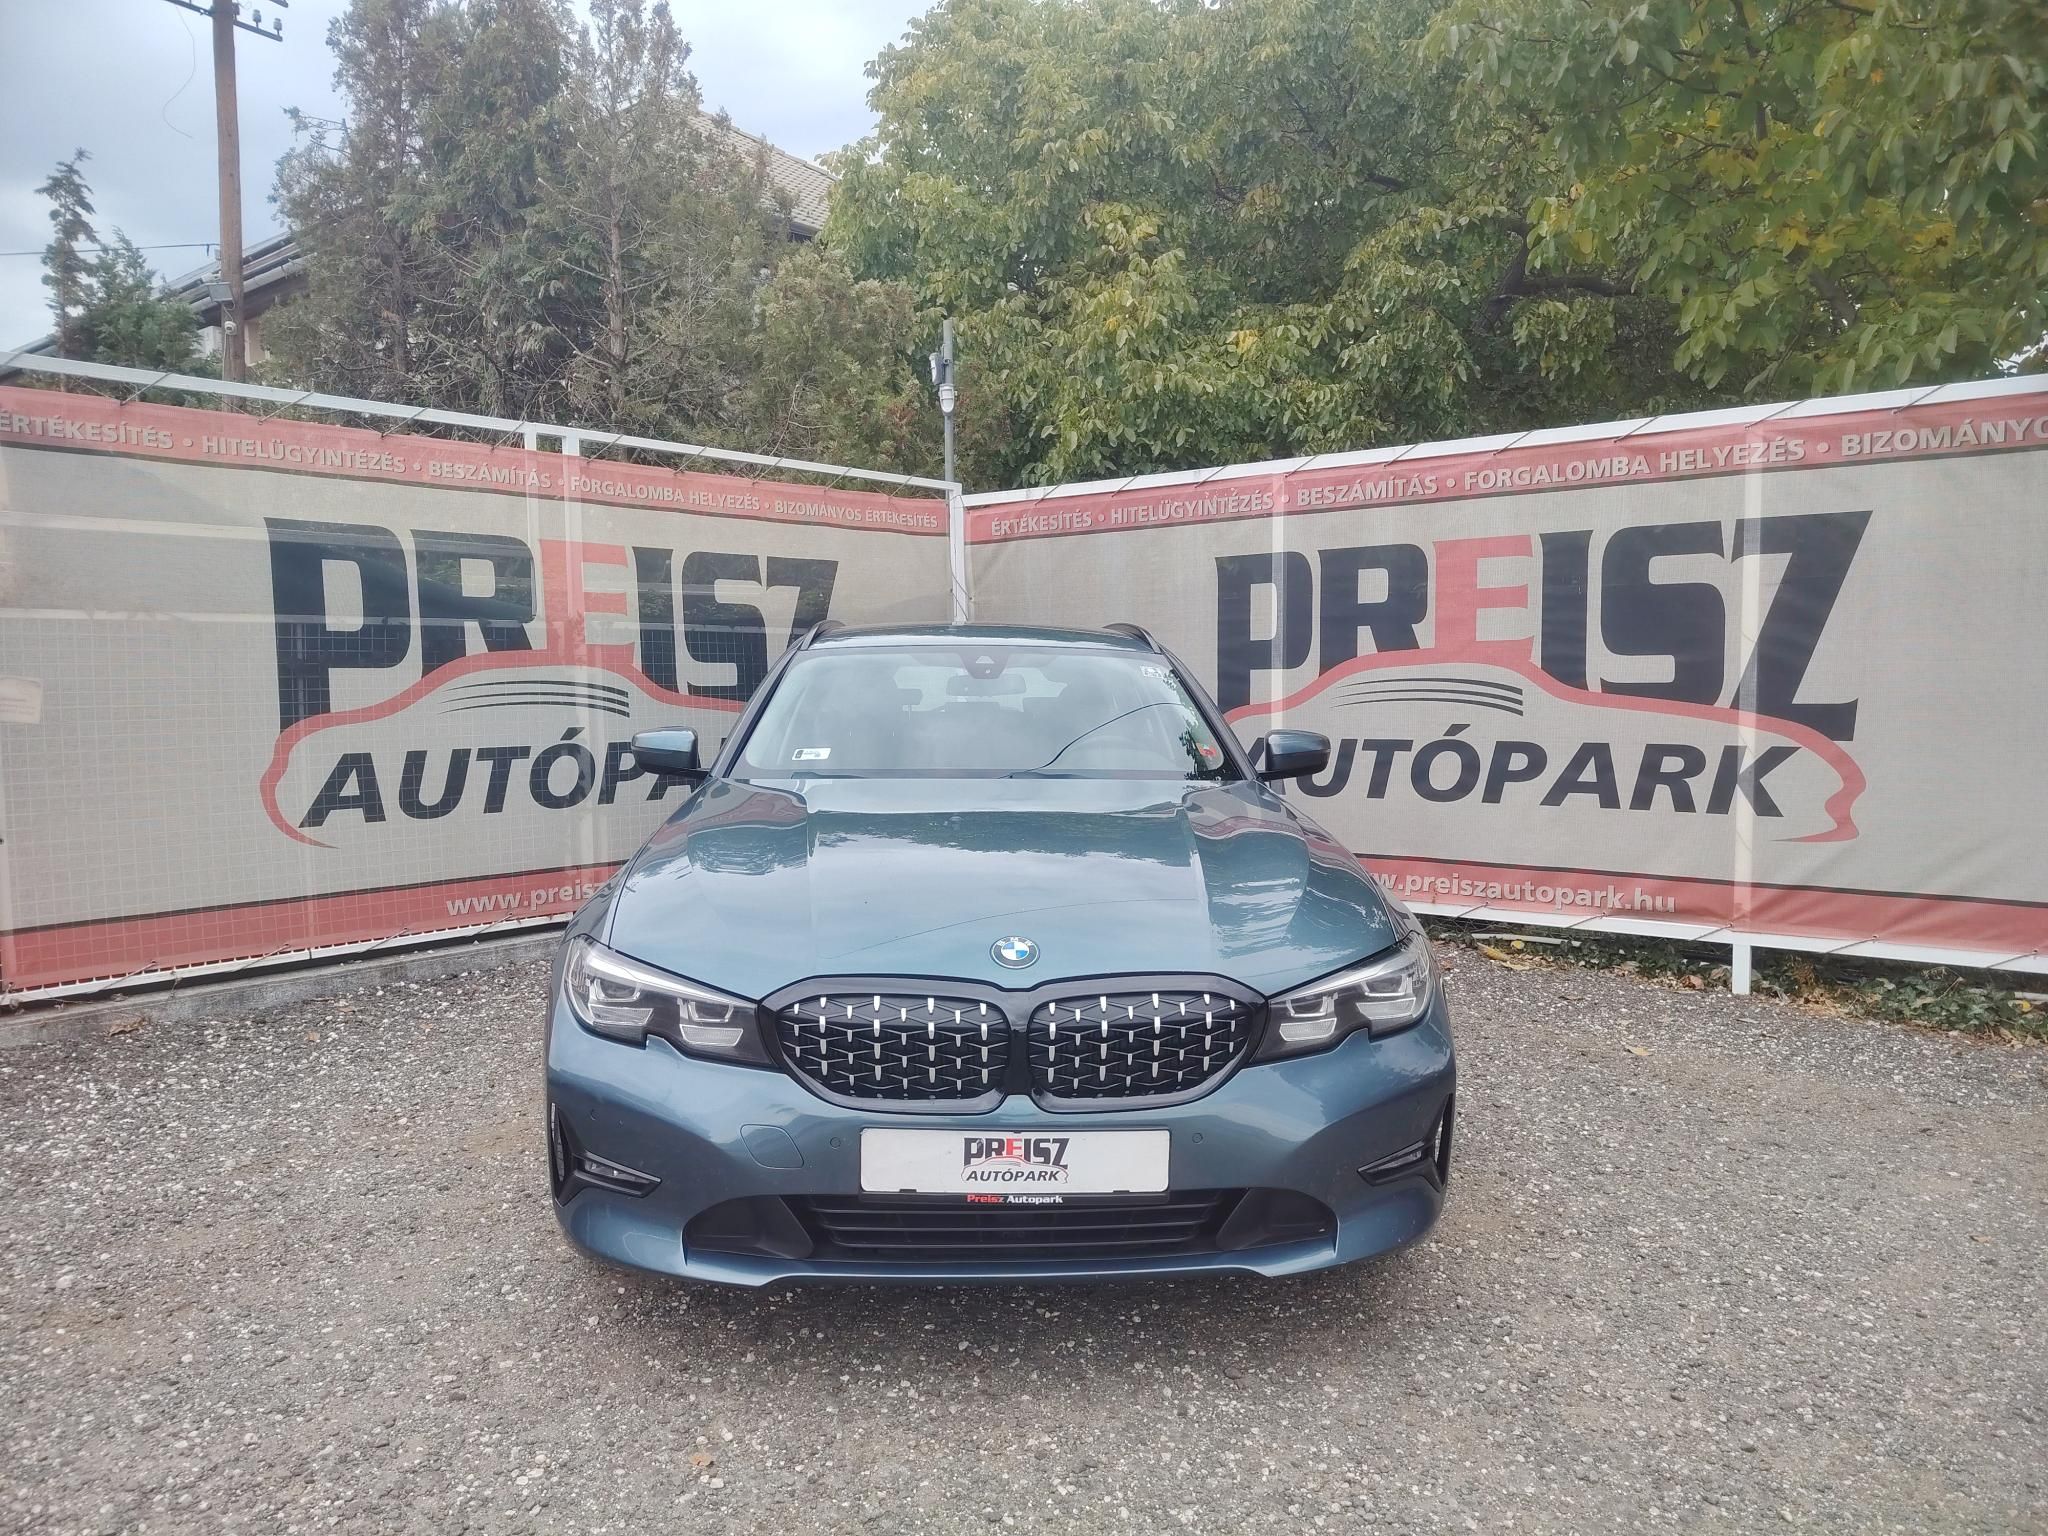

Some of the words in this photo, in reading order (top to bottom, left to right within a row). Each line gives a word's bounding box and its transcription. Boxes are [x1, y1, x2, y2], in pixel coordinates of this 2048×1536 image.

[0, 410, 174, 449] ÉRTÉKESÍTÉS
[202, 435, 407, 473] HITELÜGYINTÉZÉS
[428, 461, 552, 488] BESZÁMÍTÁS
[571, 476, 684, 503] FORGALOMBA
[689, 491, 760, 511] HELYEZÉS
[775, 499, 862, 521] BIZOMÁNYOS
[865, 507, 938, 528] ÉRTÉKESÍTÉS
[991, 510, 1093, 537] ÉRTÉKESÍTÉS
[1111, 490, 1274, 525] HITELÜGYINTÉZÉS
[1298, 473, 1438, 505] BESZÁMÍTÁS
[1464, 455, 1652, 491] FORGALOMBA
[1660, 437, 1806, 473] HELYEZÉS
[1215, 510, 1873, 742] PREISZ
[963, 1137, 1071, 1169] PREISZ
[966, 1168, 1061, 1183] AUTÓPARK
[966, 1194, 1005, 1204] Preisz
[1006, 1194, 1064, 1205] Autopark
